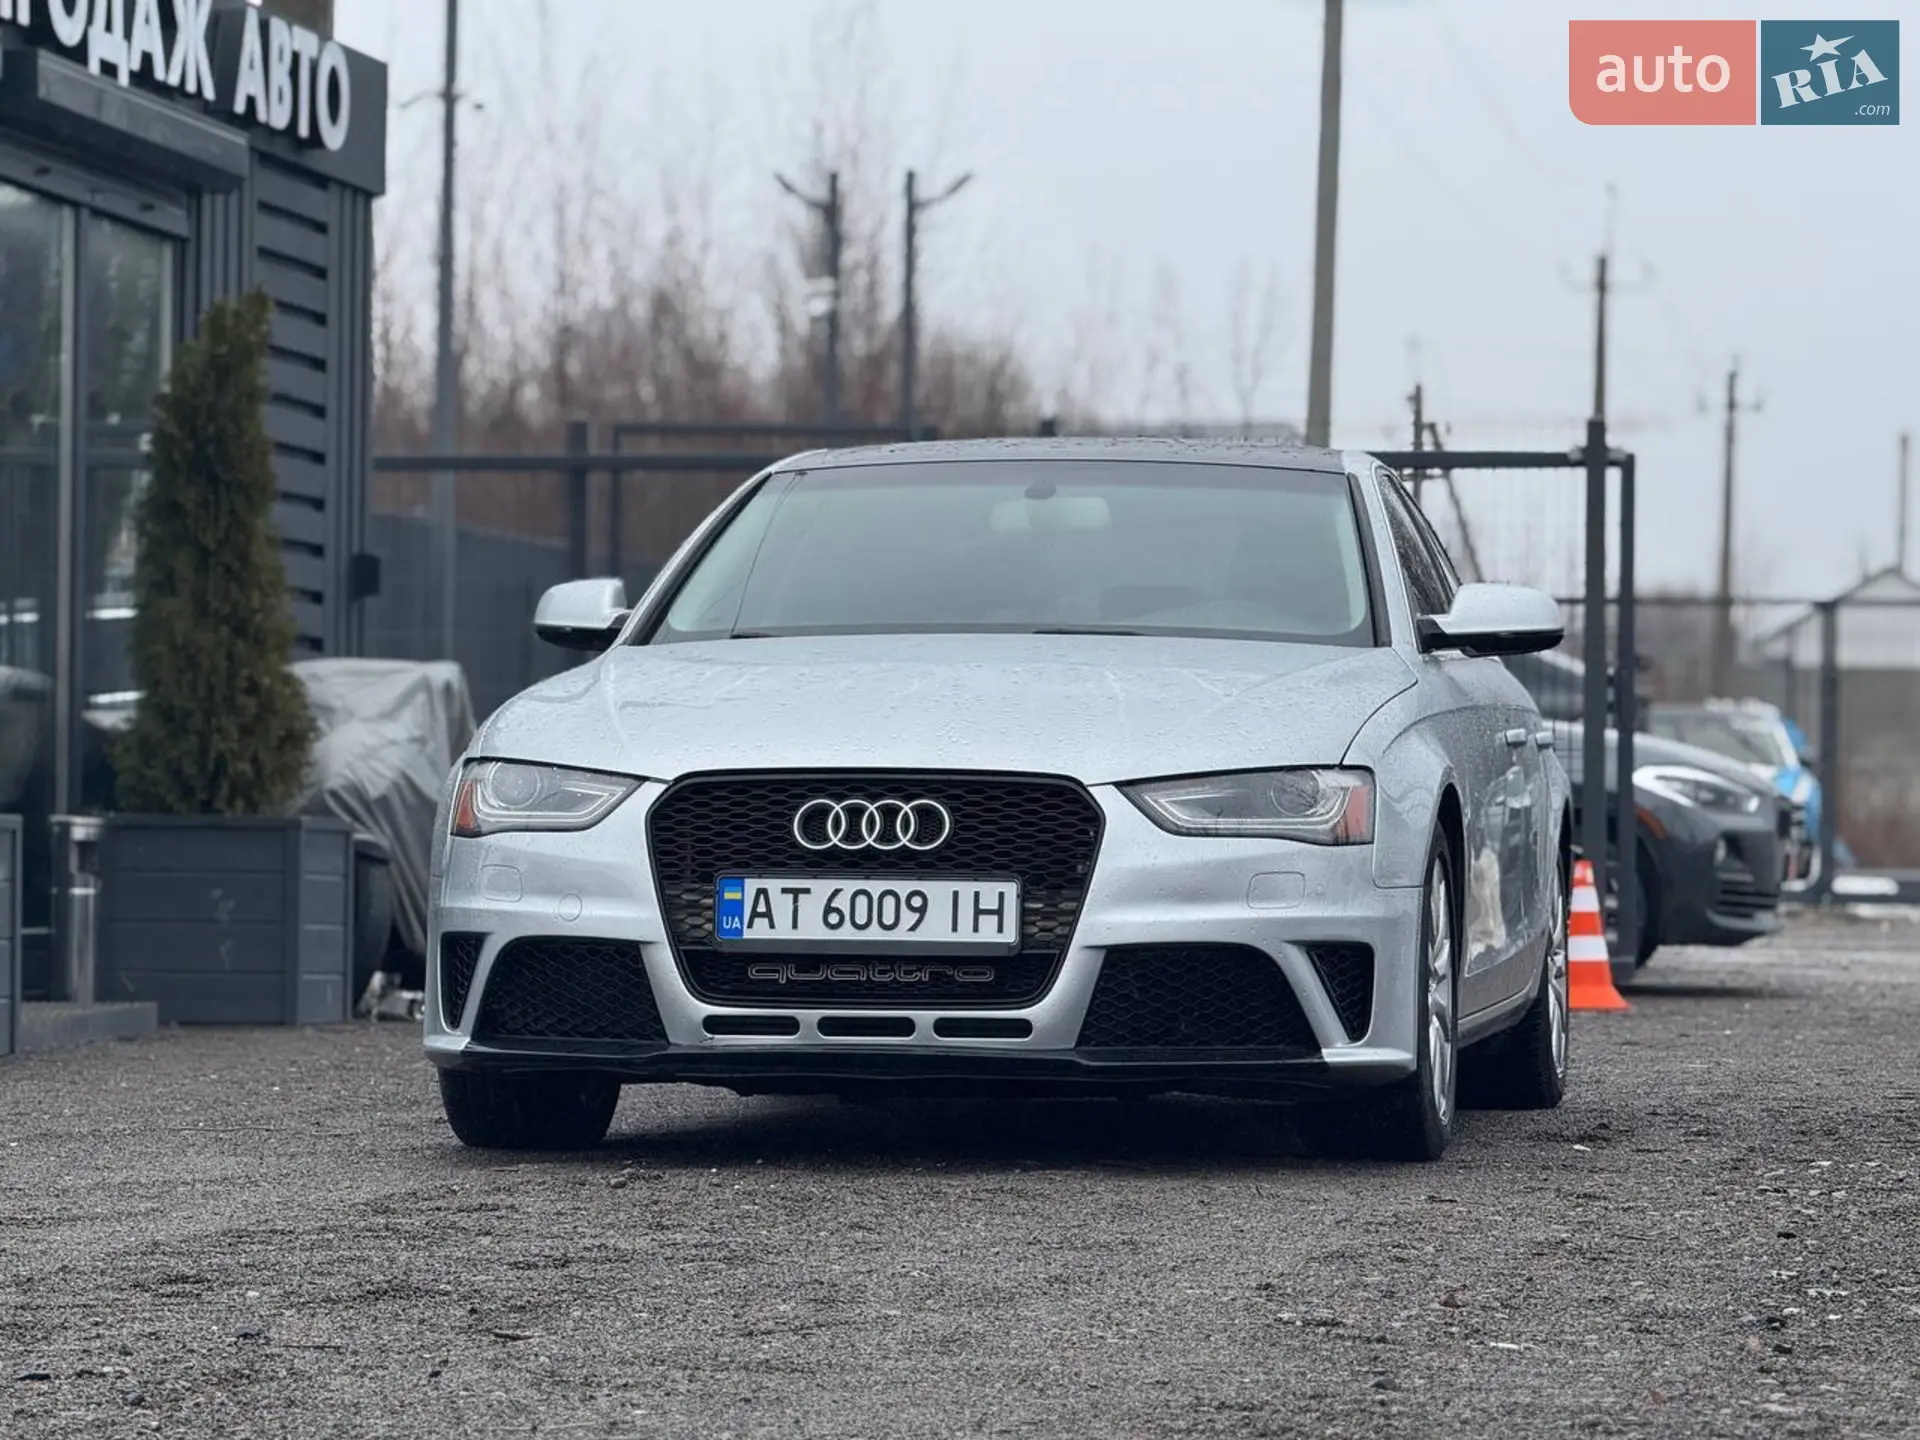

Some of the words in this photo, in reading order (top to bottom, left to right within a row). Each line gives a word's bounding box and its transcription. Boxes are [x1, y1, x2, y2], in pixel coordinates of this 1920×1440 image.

[232, 5, 351, 152] АВТО
[722, 914, 742, 930] UA
[746, 887, 812, 930] AT
[821, 888, 929, 932] 6009
[950, 889, 1005, 934] IH
[748, 960, 995, 985] quattro
